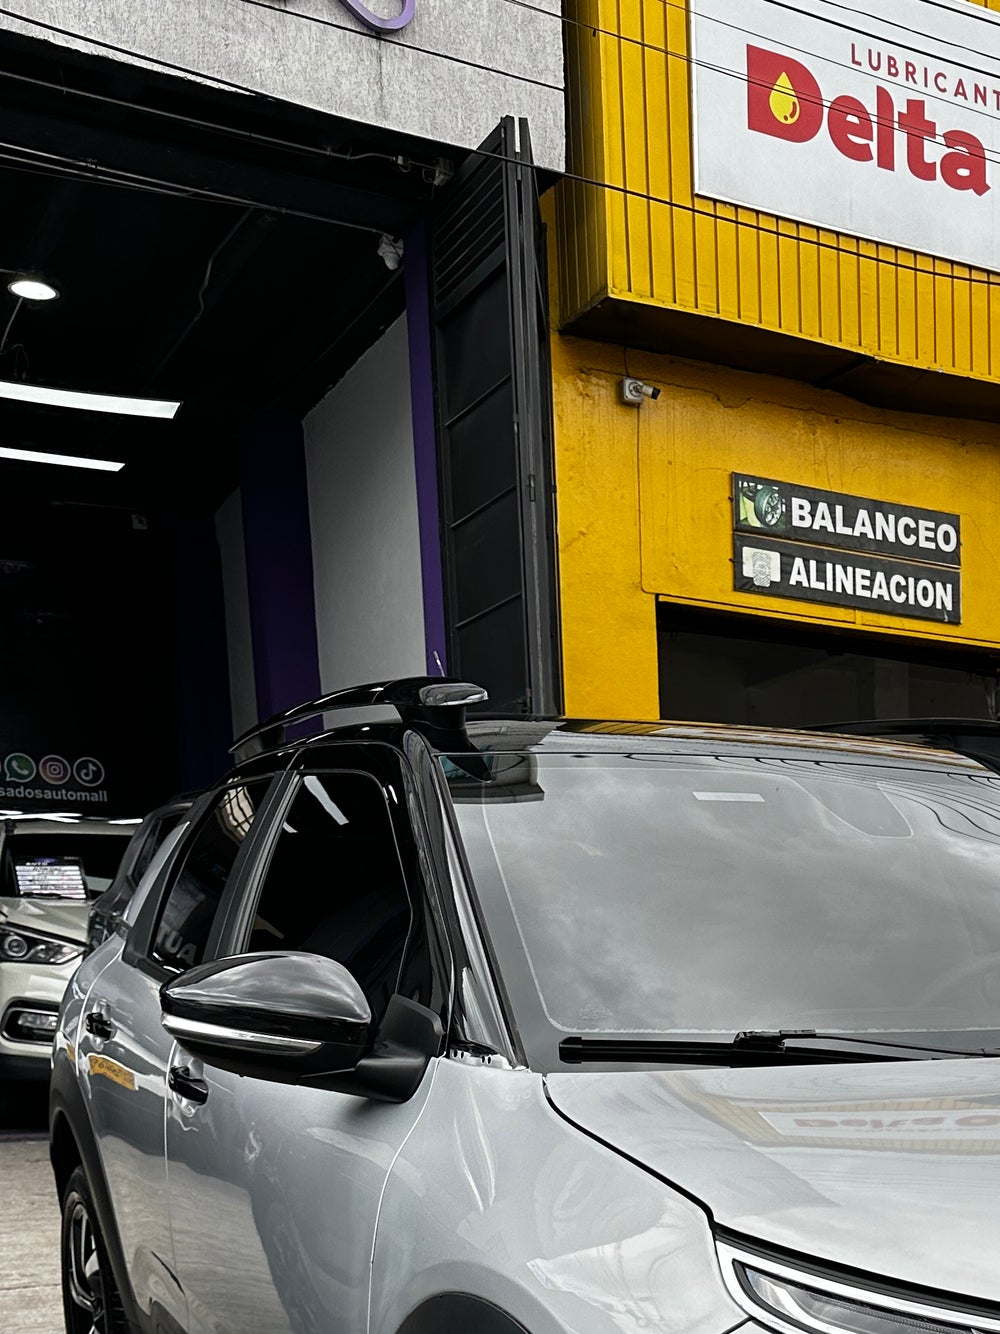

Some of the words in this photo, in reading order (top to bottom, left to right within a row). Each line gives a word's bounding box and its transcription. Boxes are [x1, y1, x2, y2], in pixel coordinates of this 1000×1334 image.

[746, 43, 991, 196] Delta
[791, 497, 957, 553] BALANCEO
[789, 557, 953, 611] ALINEACION
